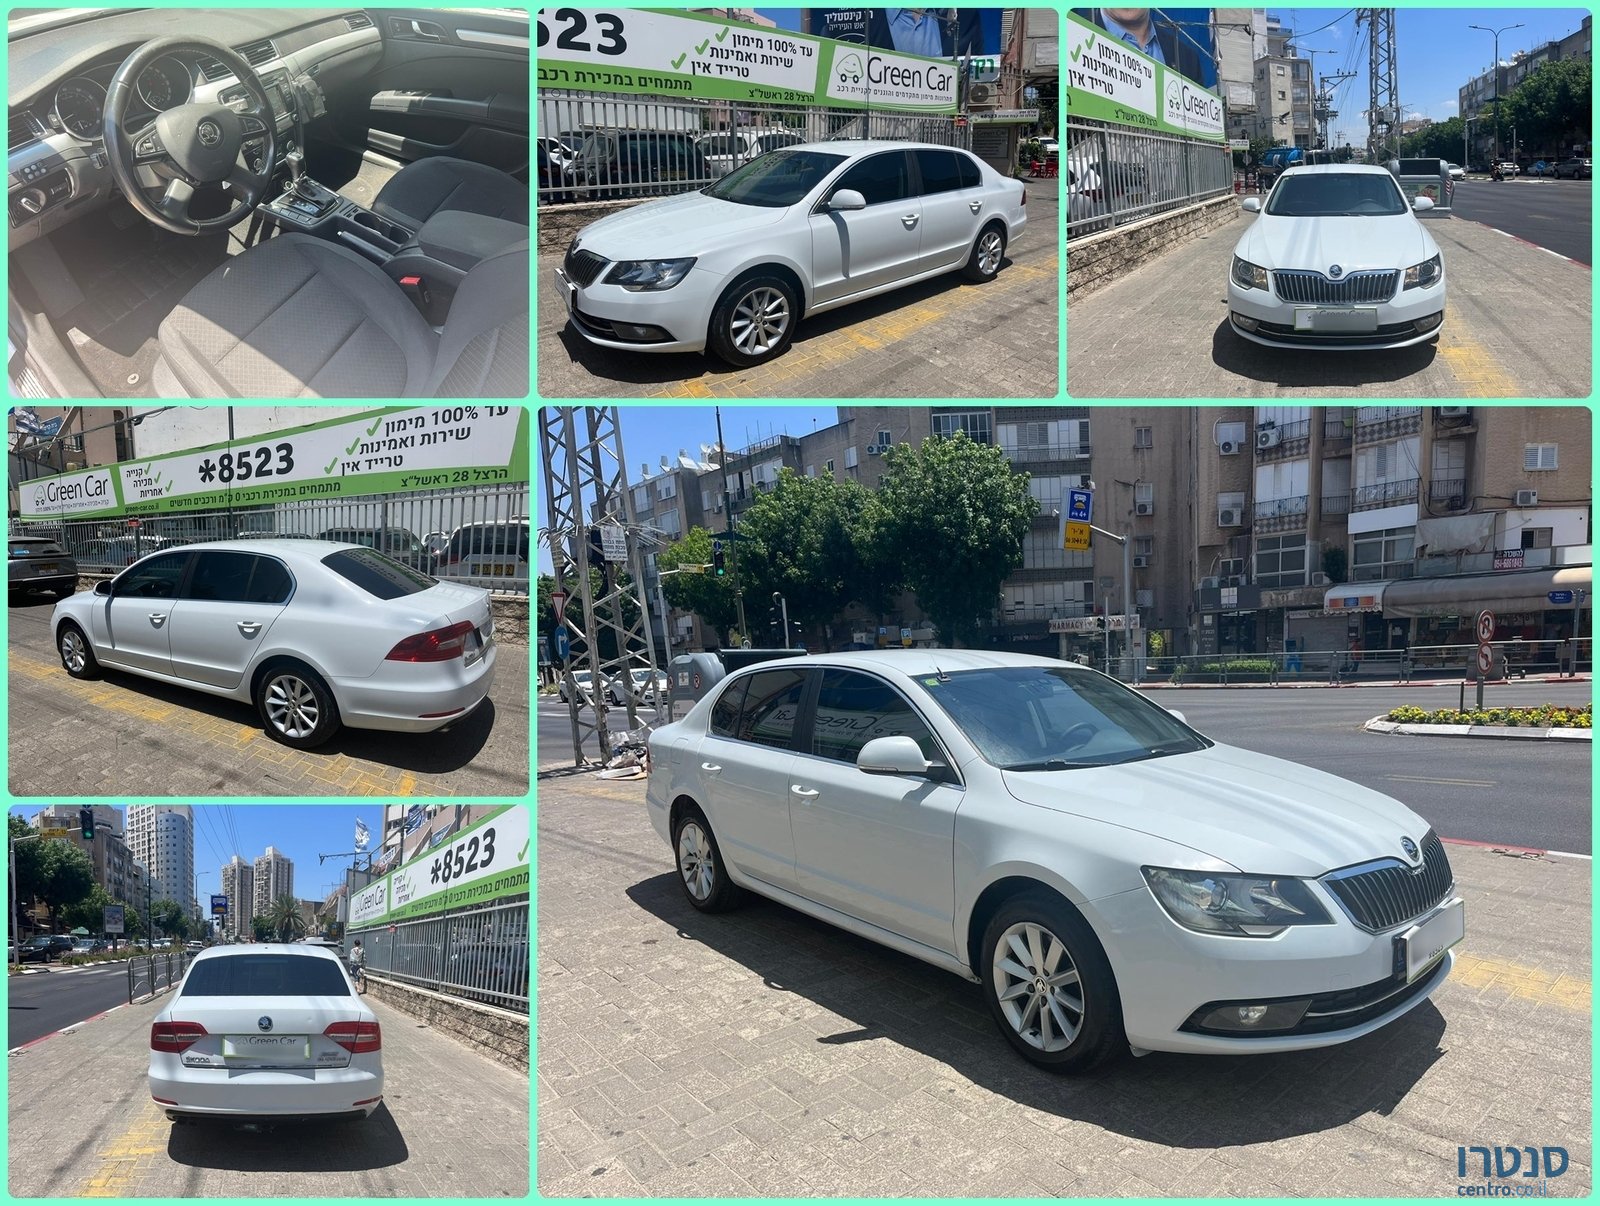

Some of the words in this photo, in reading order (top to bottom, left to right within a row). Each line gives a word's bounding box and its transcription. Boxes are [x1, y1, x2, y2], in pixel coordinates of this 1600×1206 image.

[824, 11, 862, 24] קינסטליך
[732, 34, 764, 49] מימון
[767, 39, 797, 55] 100%
[709, 47, 757, 63] ואמינות
[799, 45, 813, 57] עד
[1098, 43, 1121, 64] מימון
[691, 60, 711, 76] אין
[761, 54, 793, 69] שירות
[1082, 54, 1117, 80] ואמינות
[1122, 54, 1142, 75] 100%
[716, 64, 749, 78] טרייד
[867, 56, 922, 89] Green
[926, 66, 952, 92] Car
[1068, 69, 1086, 88] אין
[1143, 66, 1152, 79] עד
[574, 71, 634, 87] במכירת
[638, 76, 693, 91] מתמחים
[1087, 76, 1114, 95] טרייד
[1119, 70, 1142, 89] שירות
[784, 91, 795, 101] 28
[796, 92, 815, 103] הרצל
[1182, 86, 1210, 119] Green
[1210, 98, 1221, 122] Car
[431, 406, 478, 426] 100%
[385, 415, 425, 437] מימון
[420, 426, 471, 446] שירות
[359, 436, 415, 455] ואמינות
[341, 460, 361, 476] אין
[365, 455, 404, 470] טרייד
[126, 468, 143, 478] קנייה
[401, 473, 448, 488] ראשל"צ
[452, 470, 469, 483] 28
[473, 468, 508, 481] הרצל
[47, 482, 82, 502] Green
[84, 475, 108, 497] Car
[133, 478, 152, 488] מכירה
[299, 481, 341, 495] מתמחים
[140, 487, 163, 498] אחריות
[235, 492, 241, 502] 0
[242, 491, 261, 502] רכבי
[263, 487, 296, 499] במכירת
[169, 497, 192, 508] חדשים
[194, 496, 217, 506] ורכבים
[1049, 620, 1084, 631] PHARMACY
[494, 871, 529, 892] מתמחים
[360, 893, 375, 912] Green
[375, 885, 386, 906] Car
[467, 884, 493, 900] במכירת
